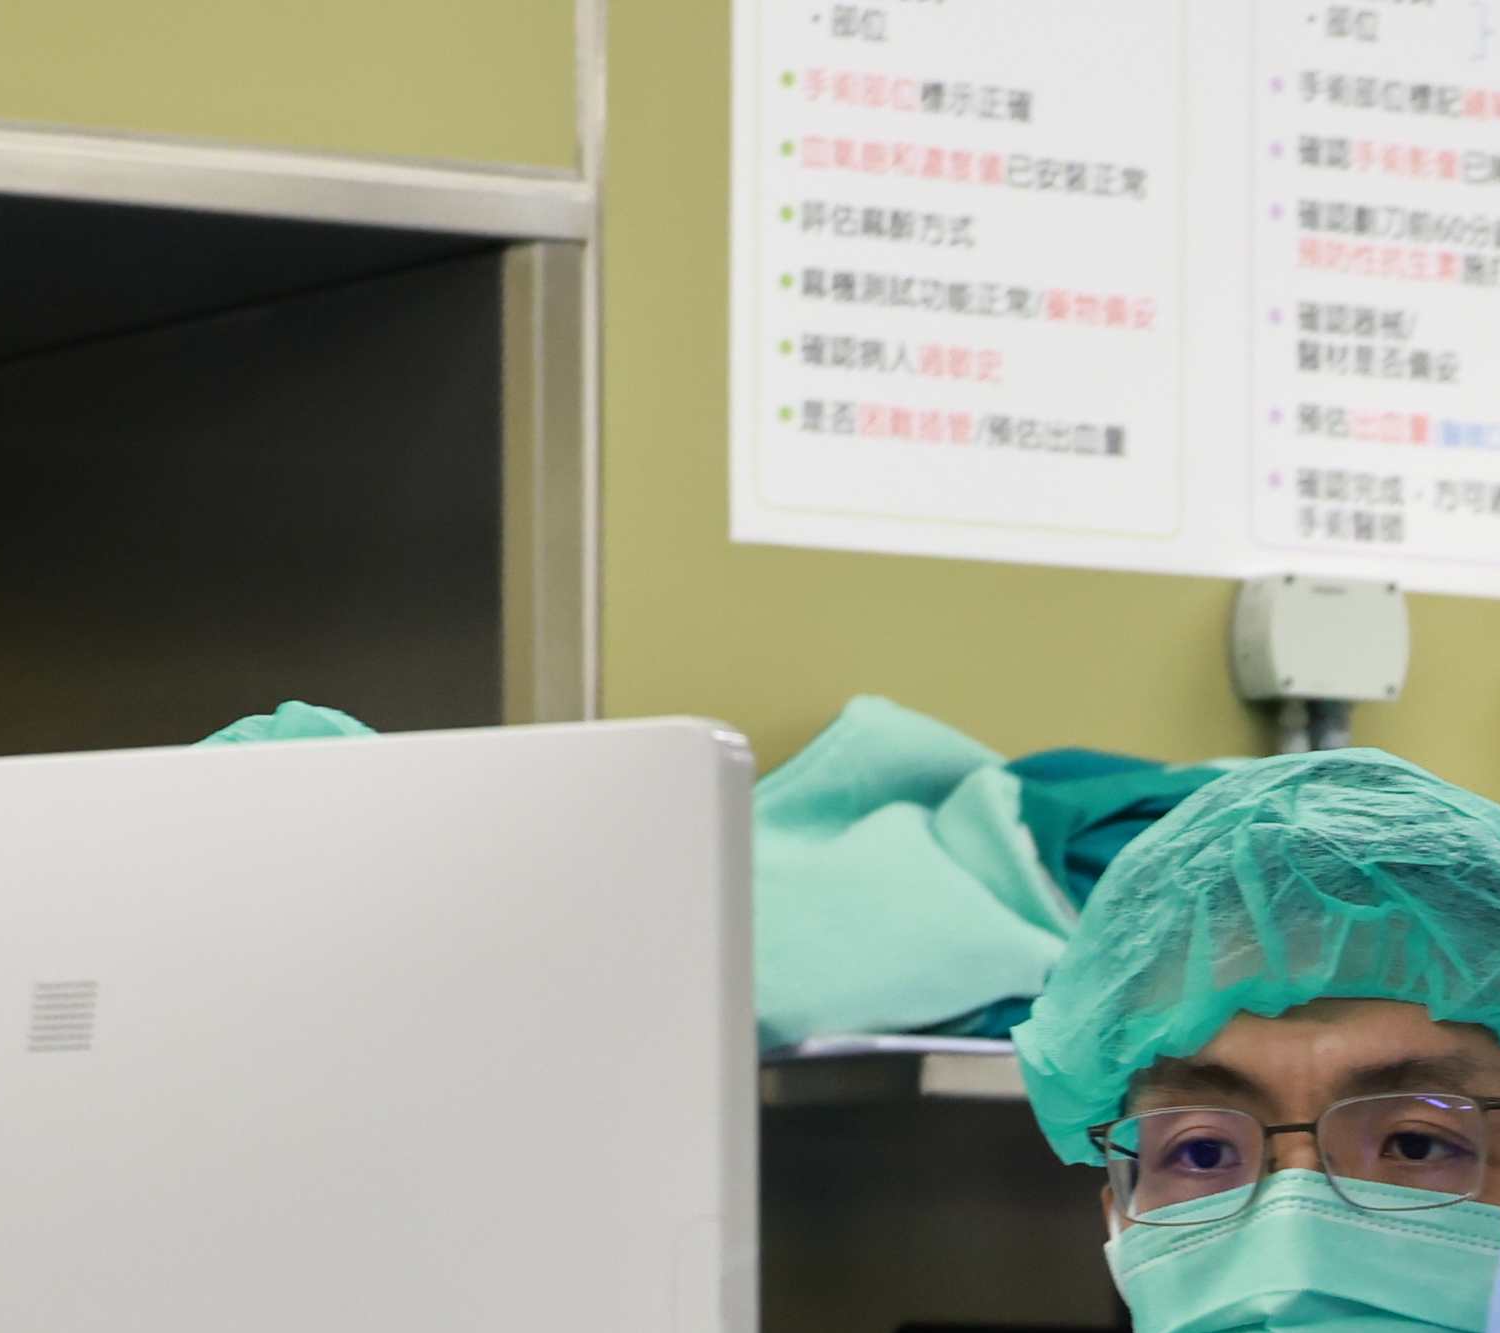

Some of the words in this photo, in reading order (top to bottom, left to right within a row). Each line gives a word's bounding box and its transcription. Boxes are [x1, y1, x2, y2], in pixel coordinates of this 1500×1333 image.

[831, 4, 888, 42] 部位
[1327, 5, 1378, 42] 部位
[804, 69, 1034, 124] 手術部位標示正確
[800, 199, 976, 249] 評估麻醉方式
[800, 333, 1001, 383] 確認病人過敏史
[1297, 336, 1459, 384] 醫材是否備妥
[1299, 505, 1404, 544] 手術醫師
